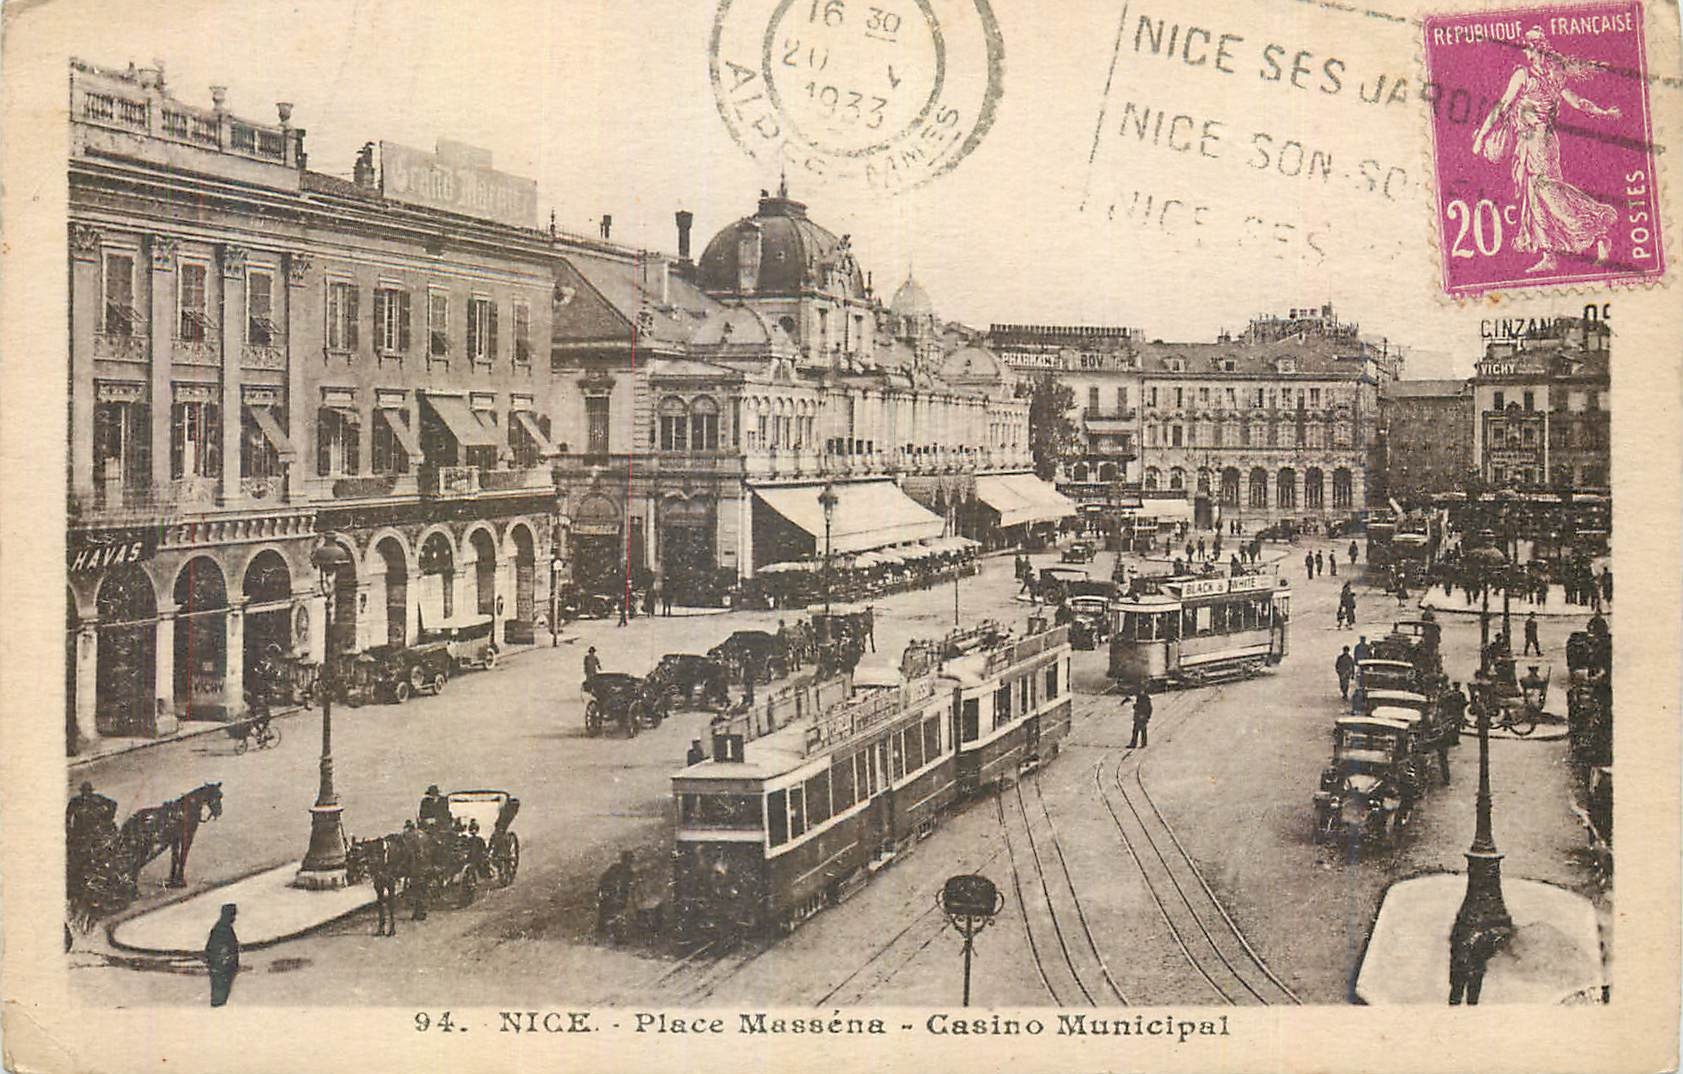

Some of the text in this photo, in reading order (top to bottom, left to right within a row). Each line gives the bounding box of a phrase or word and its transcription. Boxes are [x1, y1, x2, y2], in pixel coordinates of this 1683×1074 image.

[1550, 13, 1633, 36] FRANÇAISE
[1625, 170, 1651, 259] POSTES
[1480, 363, 1515, 374] VICHY
[71, 542, 142, 571] HAVAS
